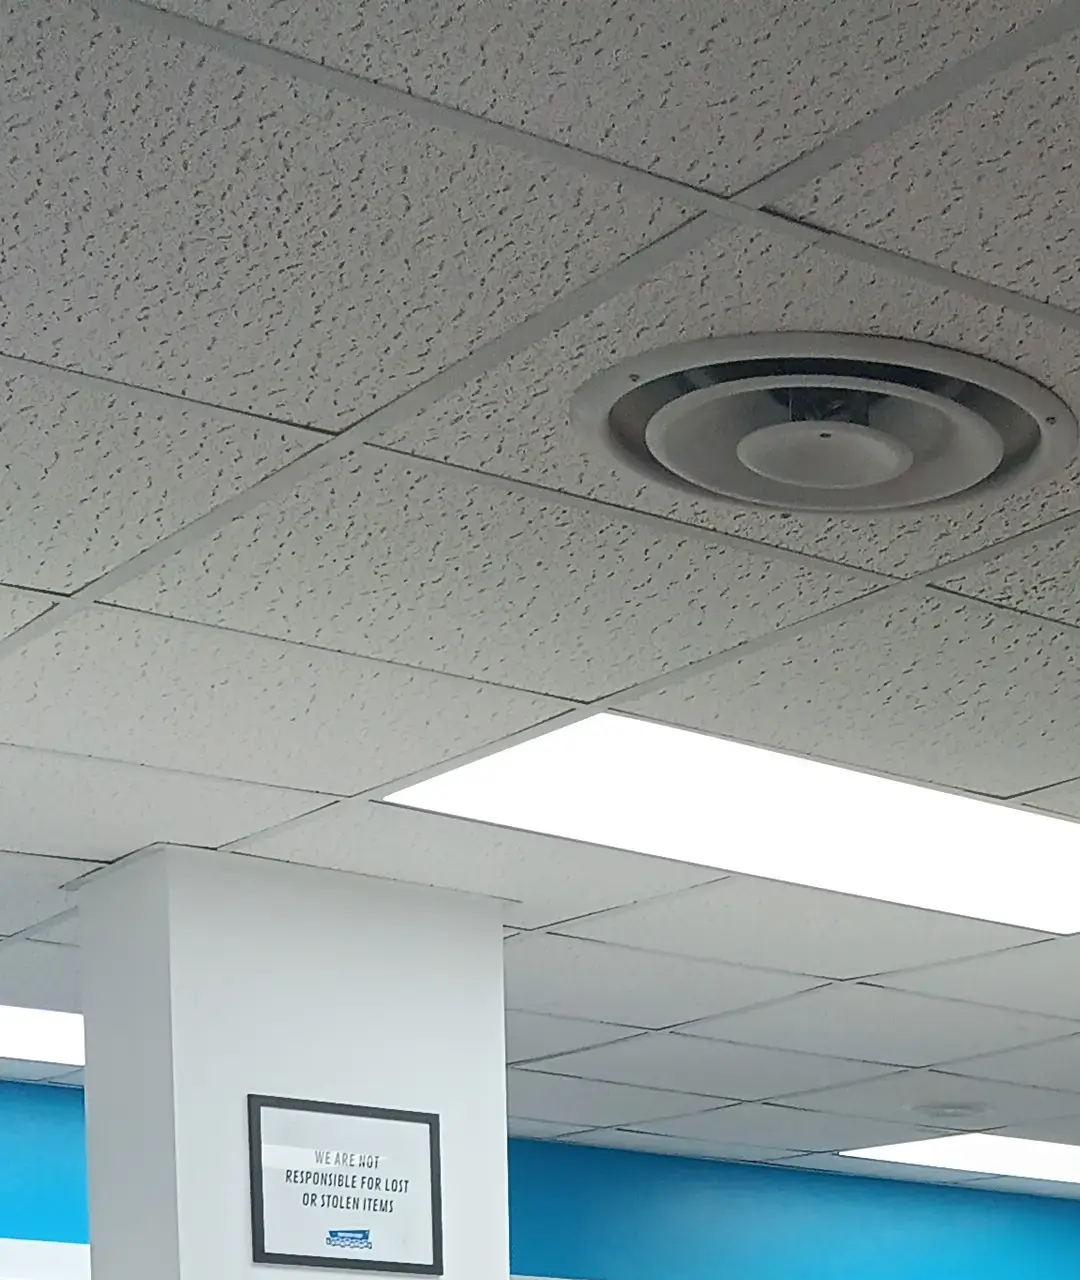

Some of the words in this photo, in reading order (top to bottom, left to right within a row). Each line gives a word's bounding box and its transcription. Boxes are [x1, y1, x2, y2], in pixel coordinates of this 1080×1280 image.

[315, 1150, 332, 1165] WE
[334, 1152, 355, 1167] ARE
[358, 1155, 380, 1169] NOT
[285, 1169, 357, 1189] RESPONSIBLE
[360, 1176, 381, 1191] FOR
[385, 1178, 409, 1193] LOST
[302, 1192, 318, 1207] OR
[321, 1194, 360, 1210] STOLEN
[363, 1197, 394, 1213] ITEMS
